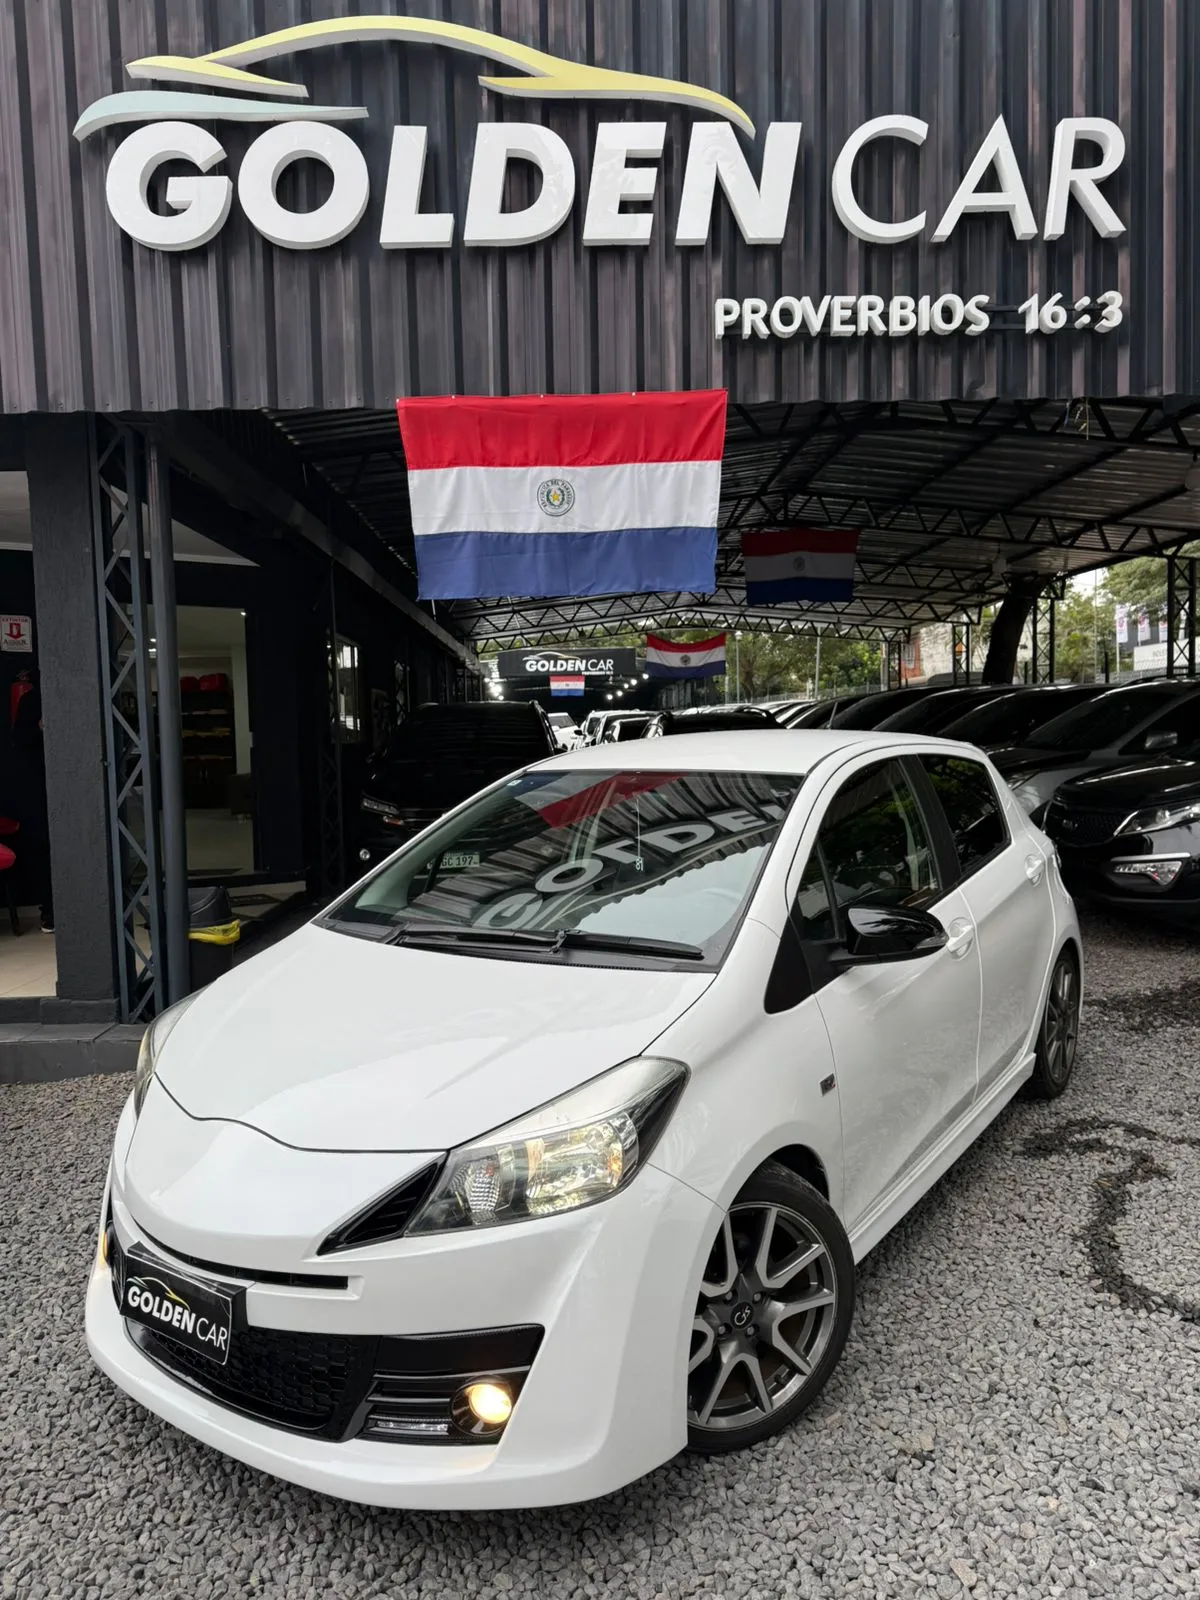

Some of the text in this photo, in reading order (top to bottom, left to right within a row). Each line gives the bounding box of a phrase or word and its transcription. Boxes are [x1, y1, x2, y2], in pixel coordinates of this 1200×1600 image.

[106, 113, 1127, 252] GOLDEN CAR
[714, 290, 1123, 340] PROVERBIOS 16:3
[525, 659, 614, 672] GOLDEN CAR
[455, 855, 474, 866] 197
[127, 1286, 228, 1351] GOLDEN CAR
